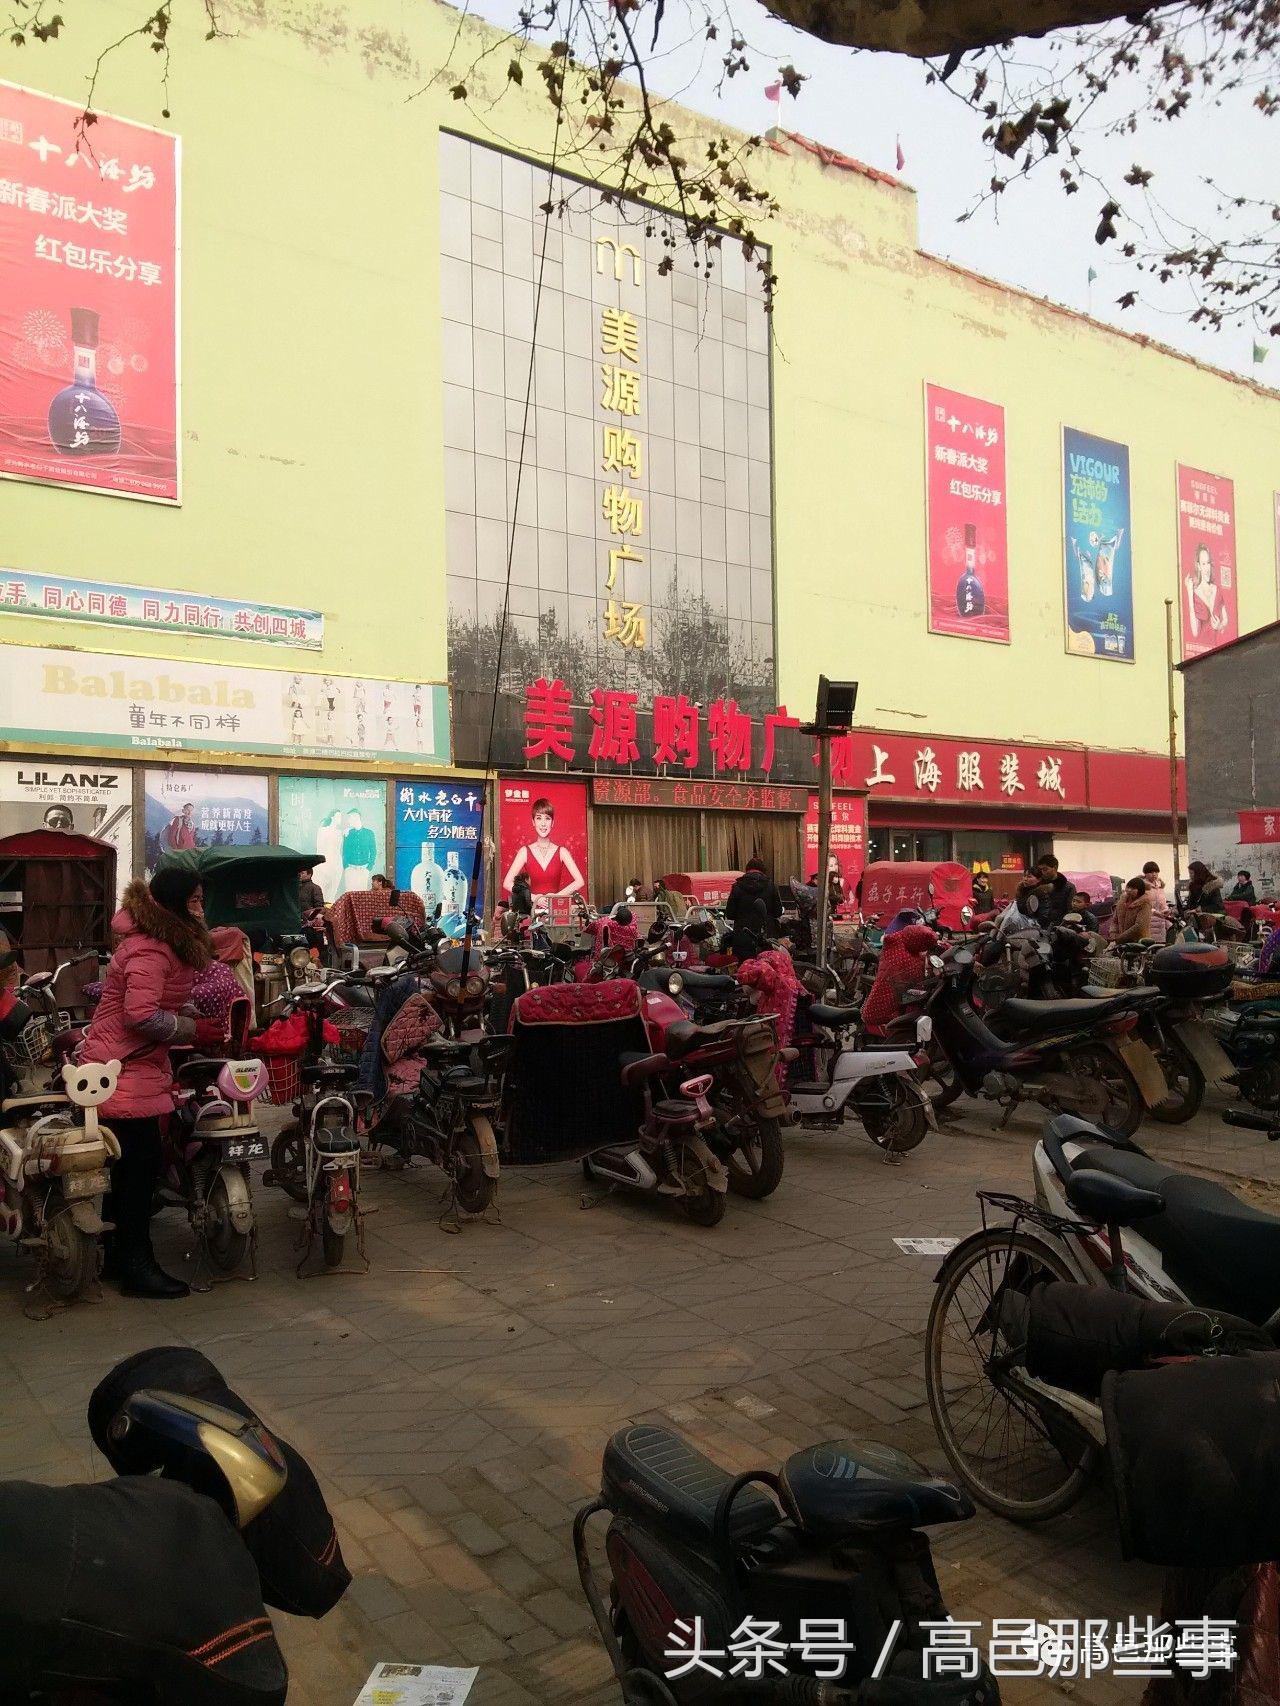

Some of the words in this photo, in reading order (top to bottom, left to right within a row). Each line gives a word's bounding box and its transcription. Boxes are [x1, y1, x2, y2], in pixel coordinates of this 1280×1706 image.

[0, 179, 128, 236] 新春派大奖
[35, 233, 162, 286] 红包乐分享
[600, 308, 647, 649] 美源购物广场
[1069, 452, 1120, 484] VIGOUR
[949, 479, 1002, 506] 红包乐分享
[43, 586, 128, 617] 同心同德
[143, 599, 221, 628] 同力同行
[235, 611, 307, 640] 共创四城
[41, 663, 257, 710] Balabala
[128, 702, 241, 733] 童年不同样
[131, 736, 183, 749] Balabala
[17, 771, 119, 789] LILANZ
[864, 744, 1067, 800] 上海服装城
[62, 788, 112, 796] SOPHISTICATED
[813, 802, 854, 811] SFEEL
[403, 808, 453, 823] 大小青花
[427, 825, 478, 841] 多少随意
